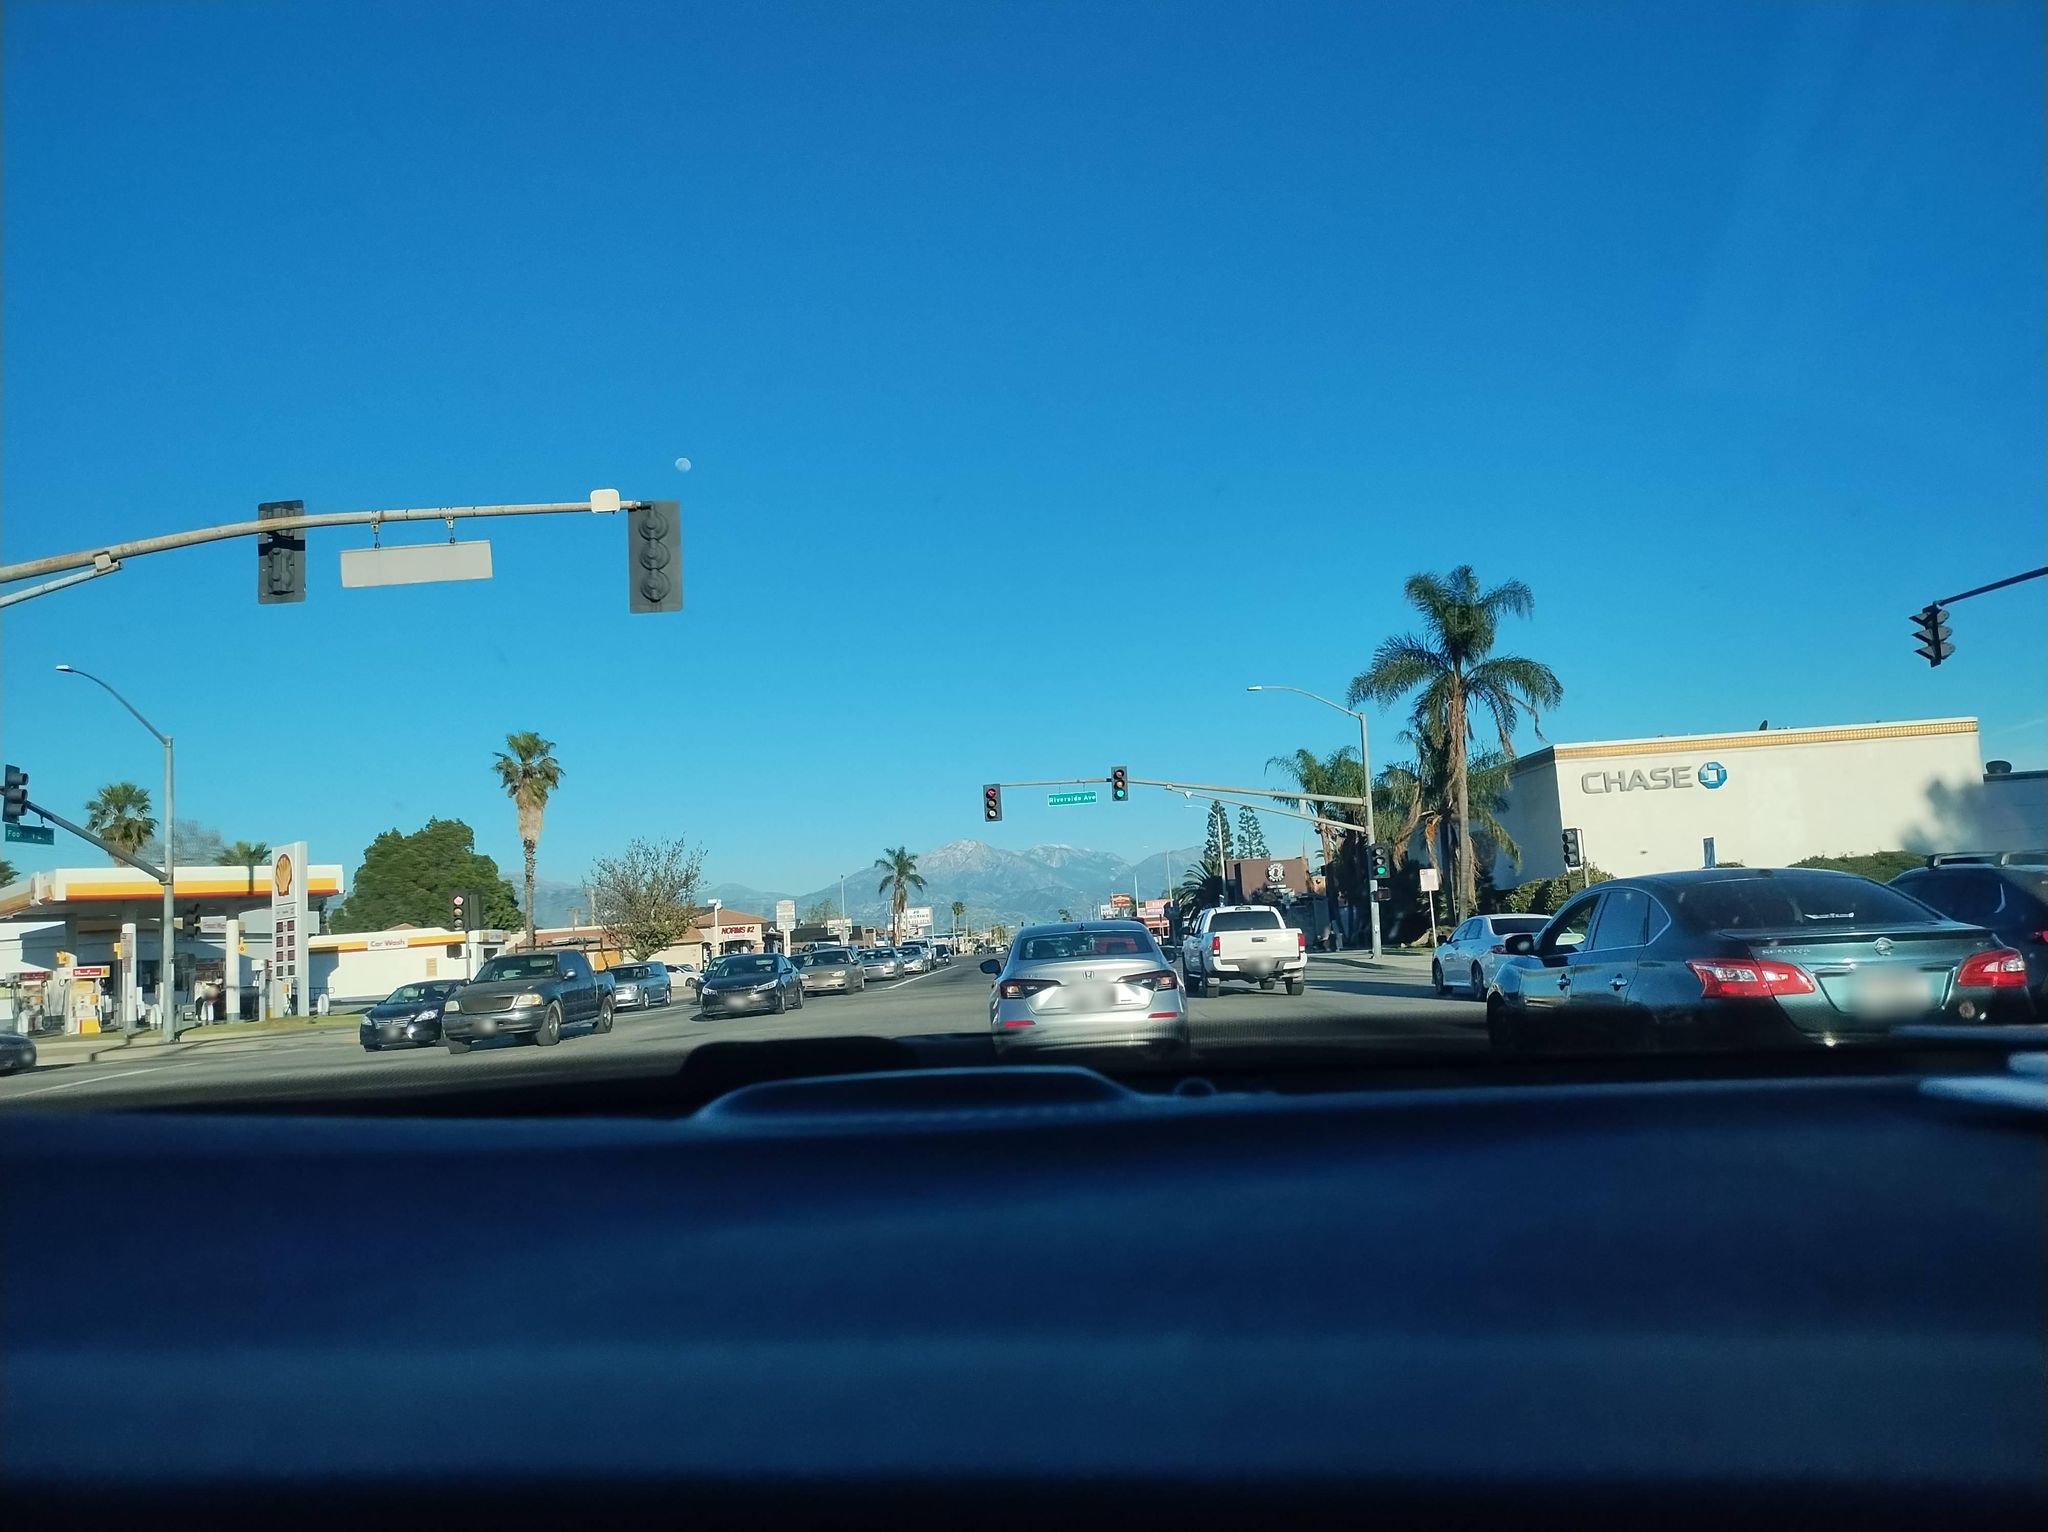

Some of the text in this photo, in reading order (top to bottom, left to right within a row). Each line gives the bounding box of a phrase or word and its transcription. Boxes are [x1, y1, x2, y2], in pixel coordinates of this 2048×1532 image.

[1581, 766, 1694, 794] CHASE
[1049, 795, 1082, 803] Riverside
[384, 938, 406, 946] Wash
